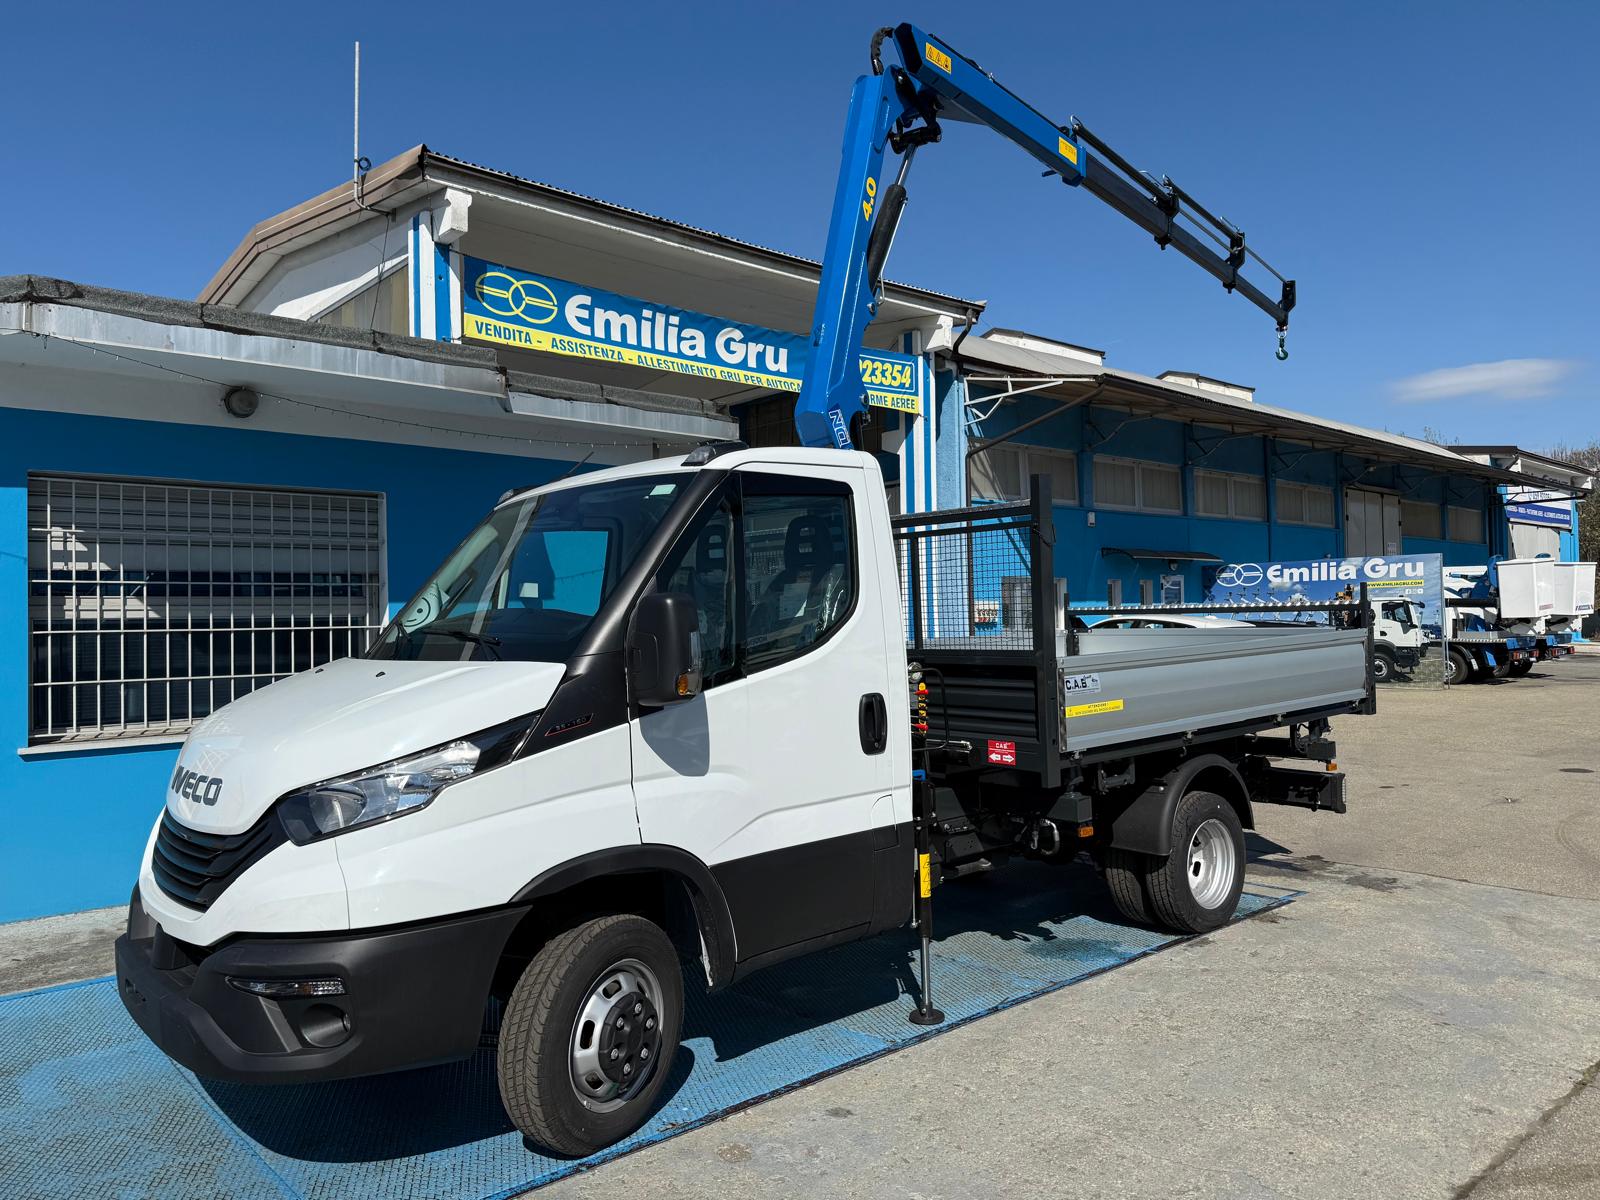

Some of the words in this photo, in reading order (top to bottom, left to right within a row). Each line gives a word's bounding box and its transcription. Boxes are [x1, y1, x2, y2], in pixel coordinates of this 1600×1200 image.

[863, 176, 877, 222] 4.0
[564, 294, 706, 359] Emilia
[715, 327, 788, 373] Gru
[475, 320, 532, 345] VENDITA
[551, 337, 625, 362] ASSISTENZA
[637, 354, 717, 379] ALLESTIMENTO
[720, 369, 741, 383] GRU
[744, 374, 764, 386] PER
[891, 396, 915, 410] AEREE
[1266, 561, 1357, 583] Emilia
[1363, 557, 1424, 579] Gru
[171, 765, 223, 807] IVECO
